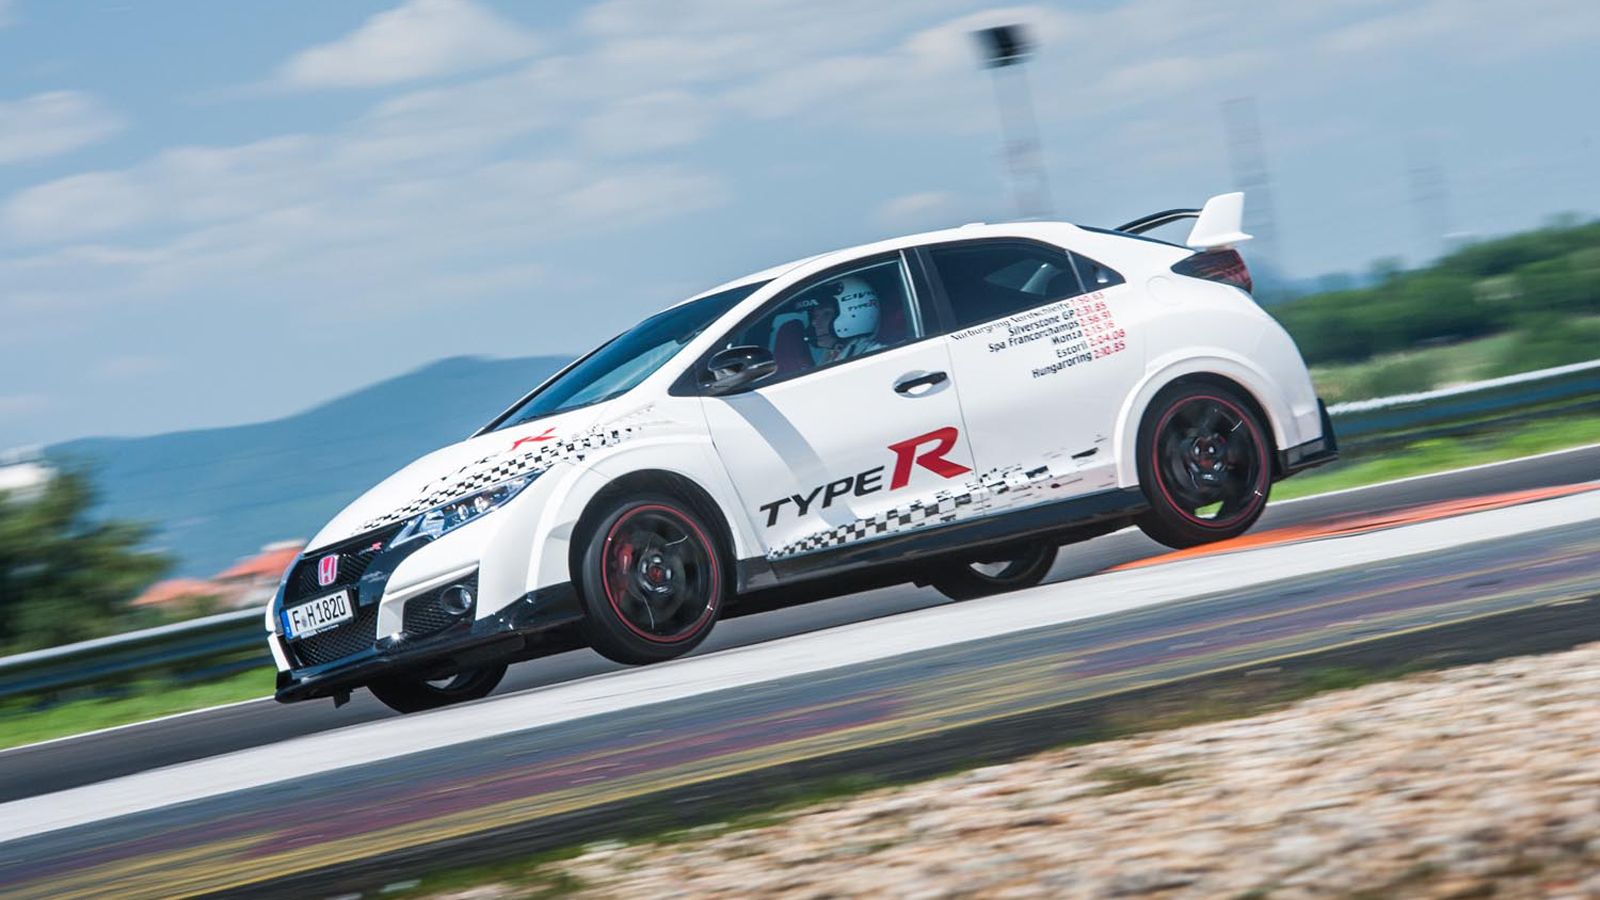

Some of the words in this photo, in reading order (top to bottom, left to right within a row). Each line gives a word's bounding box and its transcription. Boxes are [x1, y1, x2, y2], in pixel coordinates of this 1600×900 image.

[988, 341, 1006, 352] Spa
[1008, 320, 1079, 347] Francorchamps
[1008, 316, 1060, 336] Silverstone
[1062, 309, 1075, 321] GP
[1051, 329, 1083, 345] Monza
[1056, 340, 1088, 358] Estoril
[1032, 351, 1092, 378] Hungaroring
[759, 465, 885, 528] TYPE
[887, 426, 973, 491] R
[292, 610, 301, 632] F
